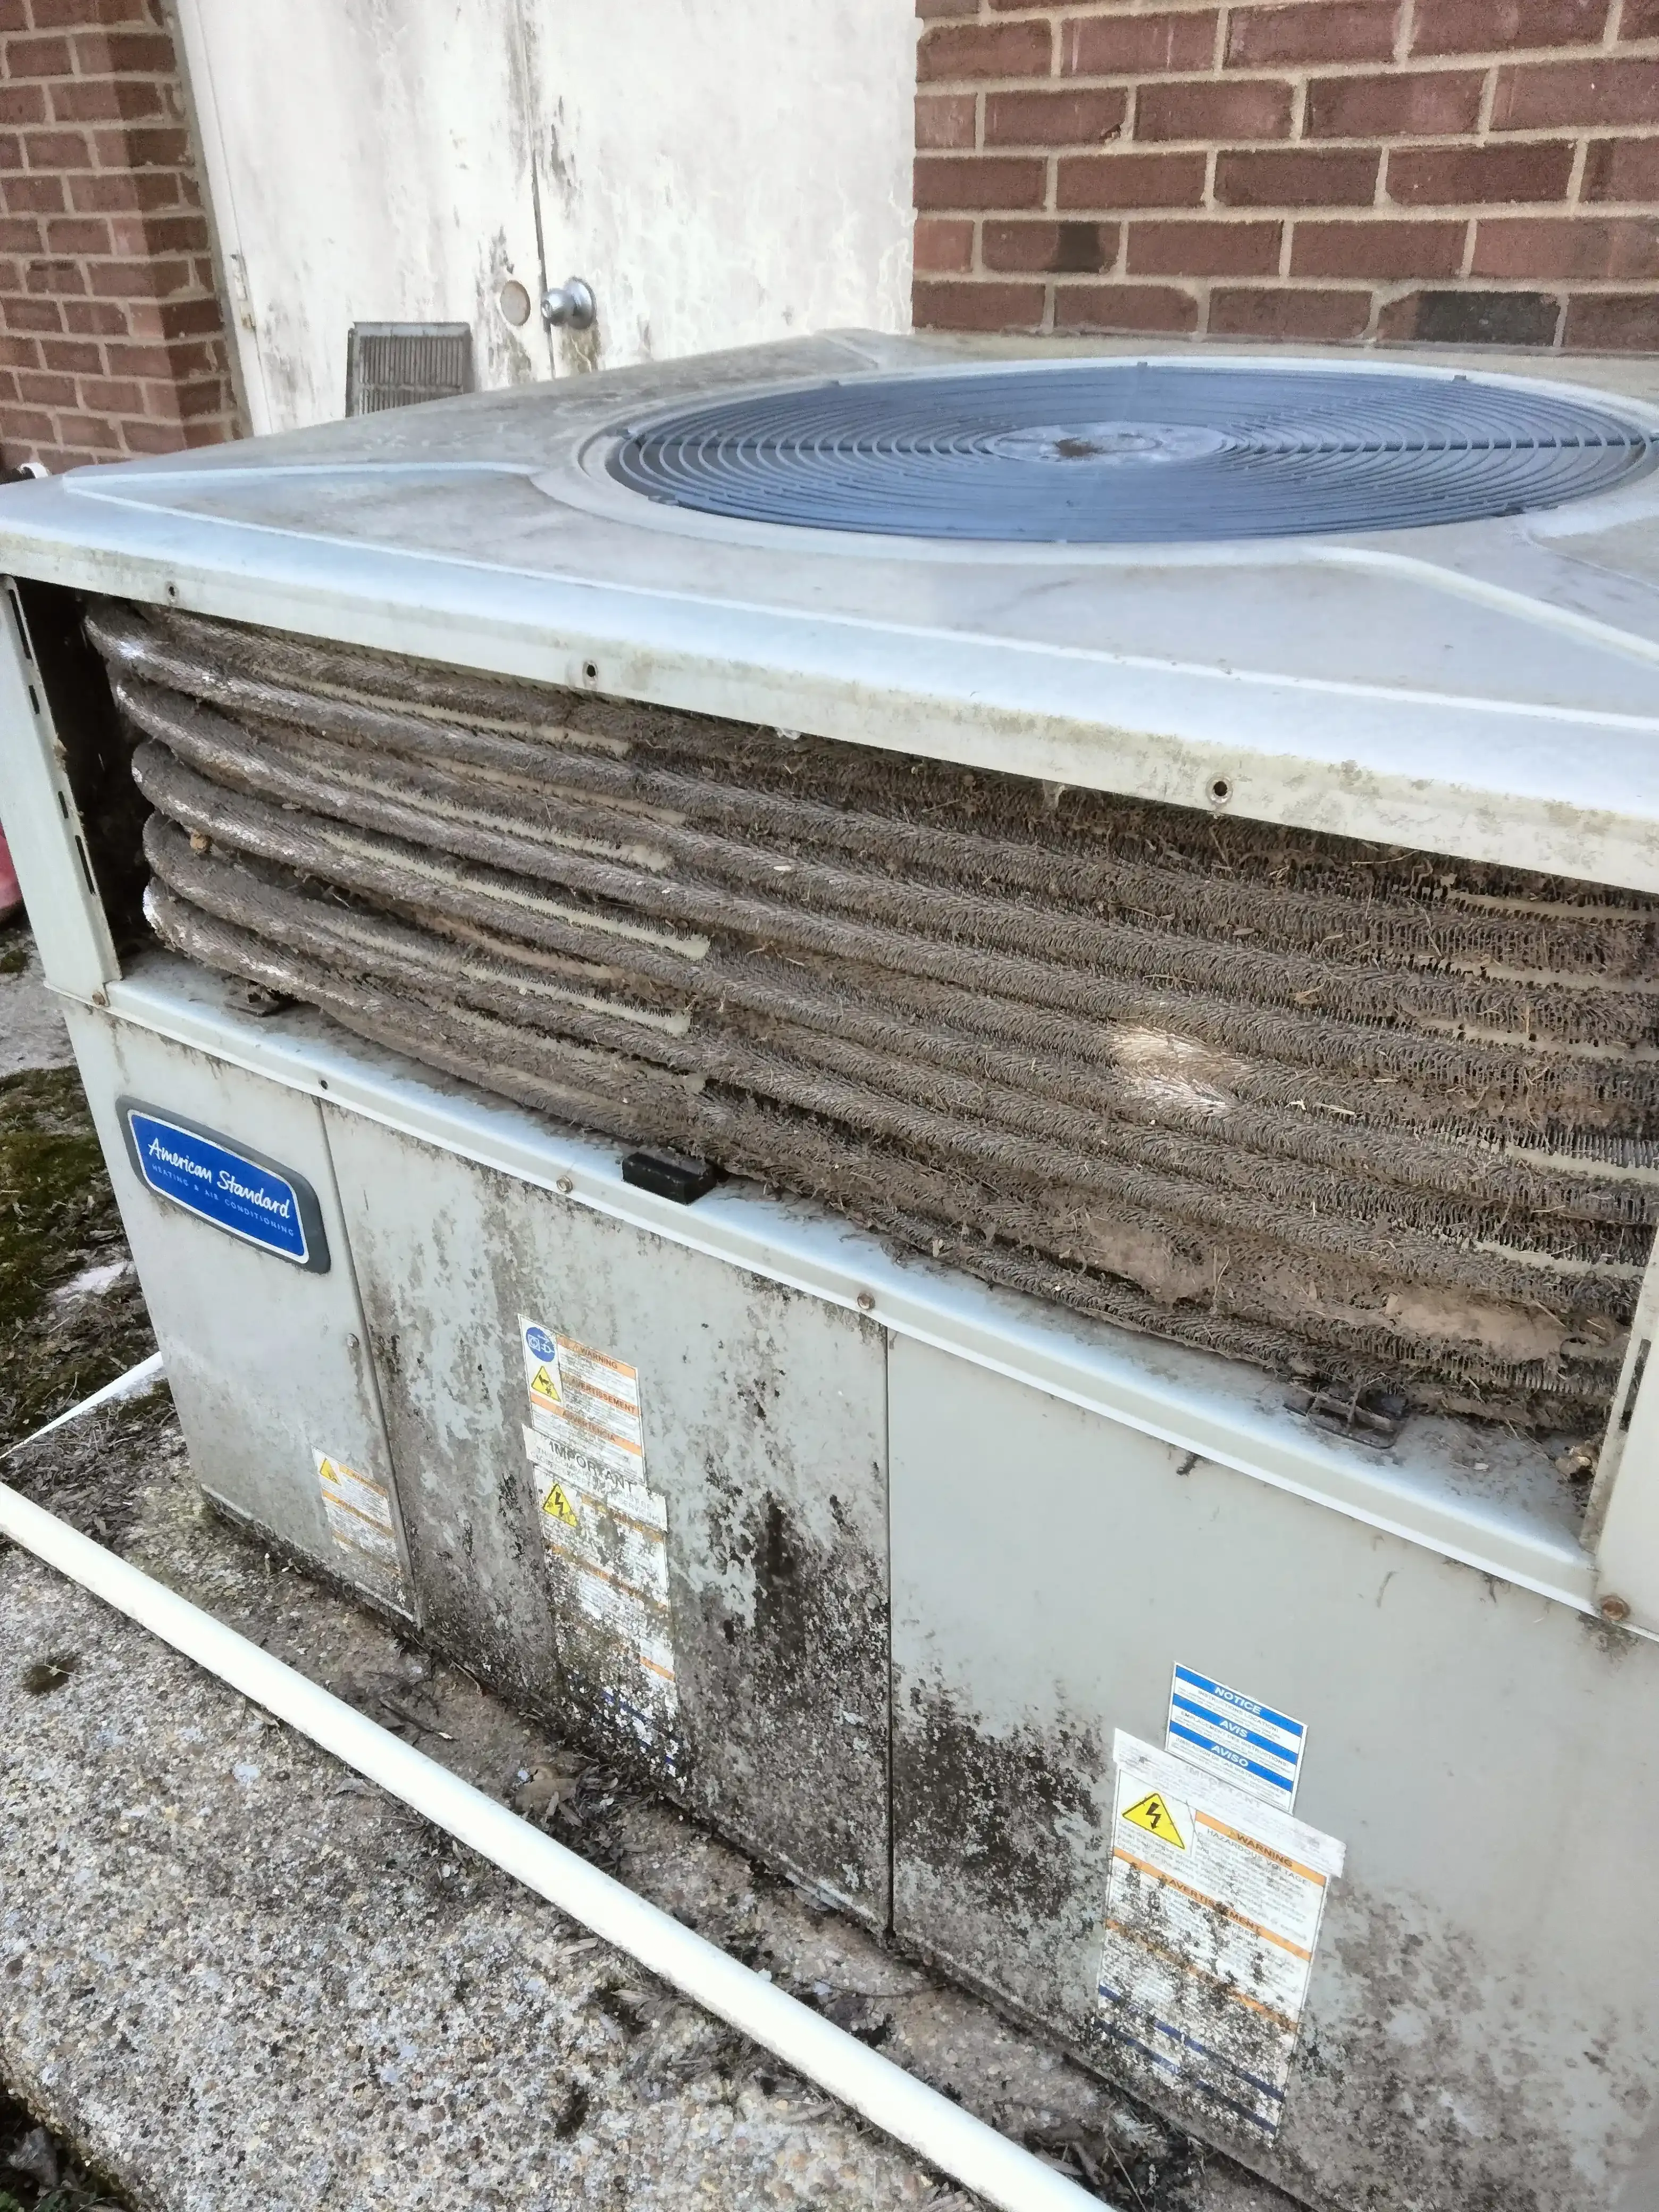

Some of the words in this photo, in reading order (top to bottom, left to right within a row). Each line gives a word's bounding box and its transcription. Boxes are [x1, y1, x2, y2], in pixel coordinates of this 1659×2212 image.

[148, 1137, 212, 1183] American
[217, 1170, 290, 1219] Standard
[152, 1164, 189, 1187] HEATING
[205, 1189, 219, 1200] AIR
[224, 1199, 295, 1237] CONDITIONING
[580, 1346, 618, 1370] WARNING
[549, 1441, 635, 1493] IMPORANT
[1214, 1686, 1263, 1715] NOTICE
[1219, 1720, 1249, 1738] AVIS
[1210, 1744, 1250, 1767] AVISO
[1237, 1833, 1293, 1867] WARNING
[1169, 1879, 1261, 1934] AVERTISMENT
